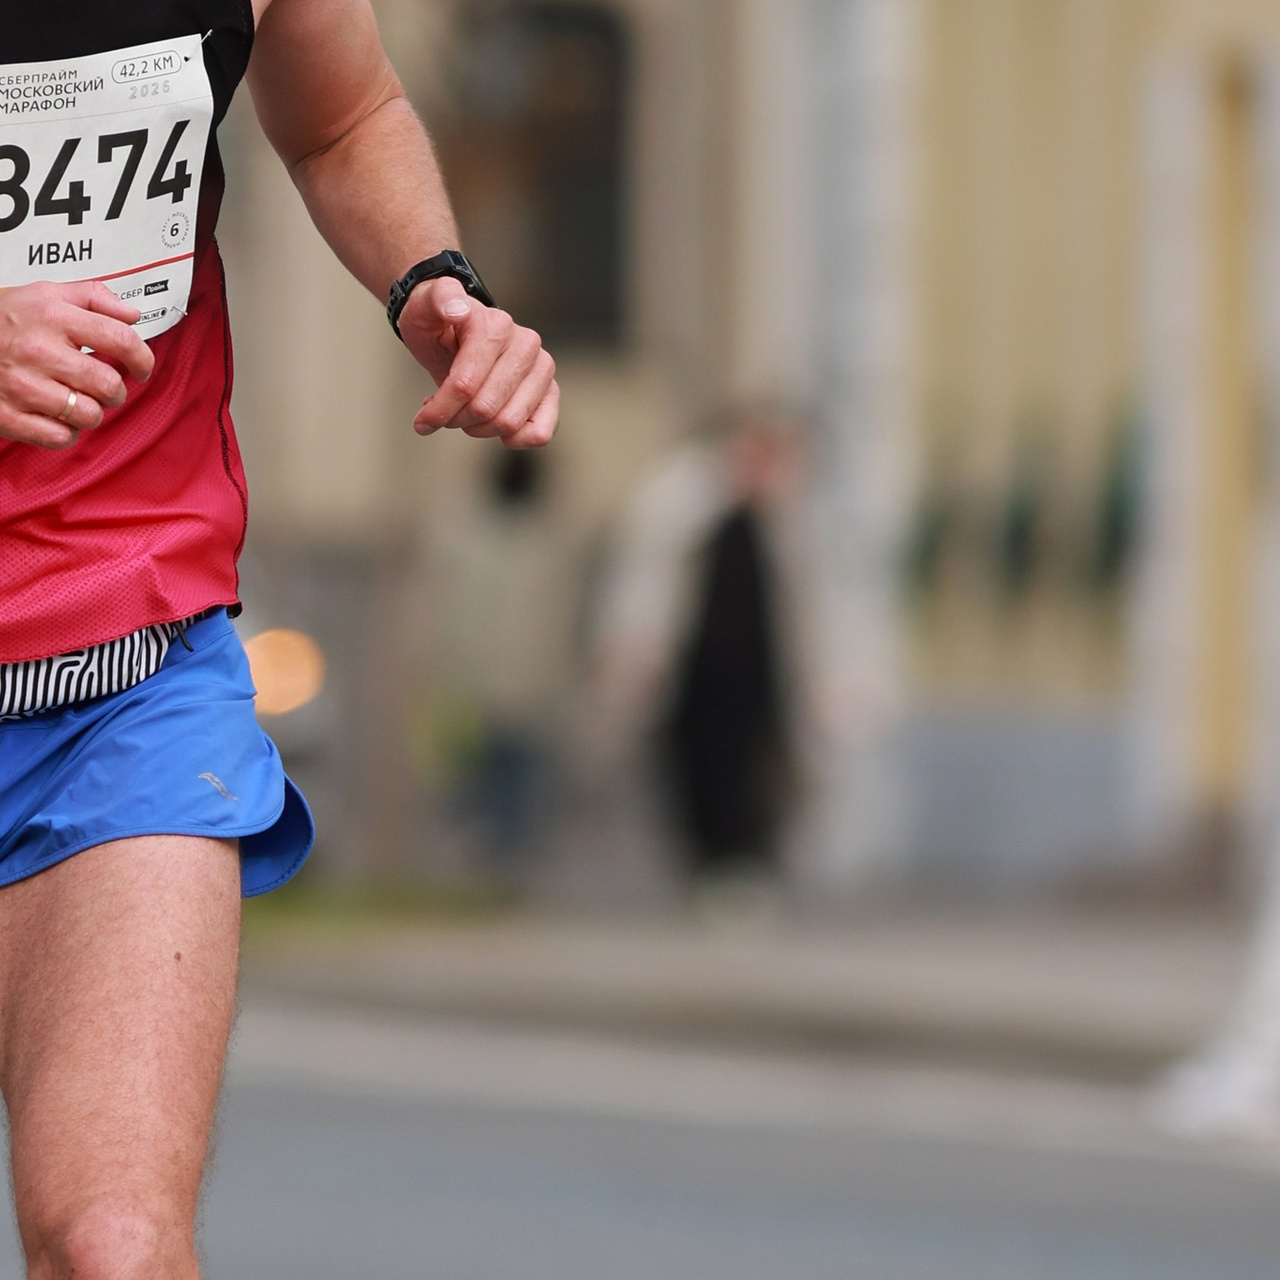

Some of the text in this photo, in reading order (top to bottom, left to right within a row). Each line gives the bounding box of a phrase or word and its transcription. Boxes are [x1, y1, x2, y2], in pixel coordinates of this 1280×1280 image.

[120, 60, 148, 78] 42,2
[170, 222, 179, 237] 6
[28, 238, 94, 266] ИВАН
[120, 287, 143, 300] СБЕР
